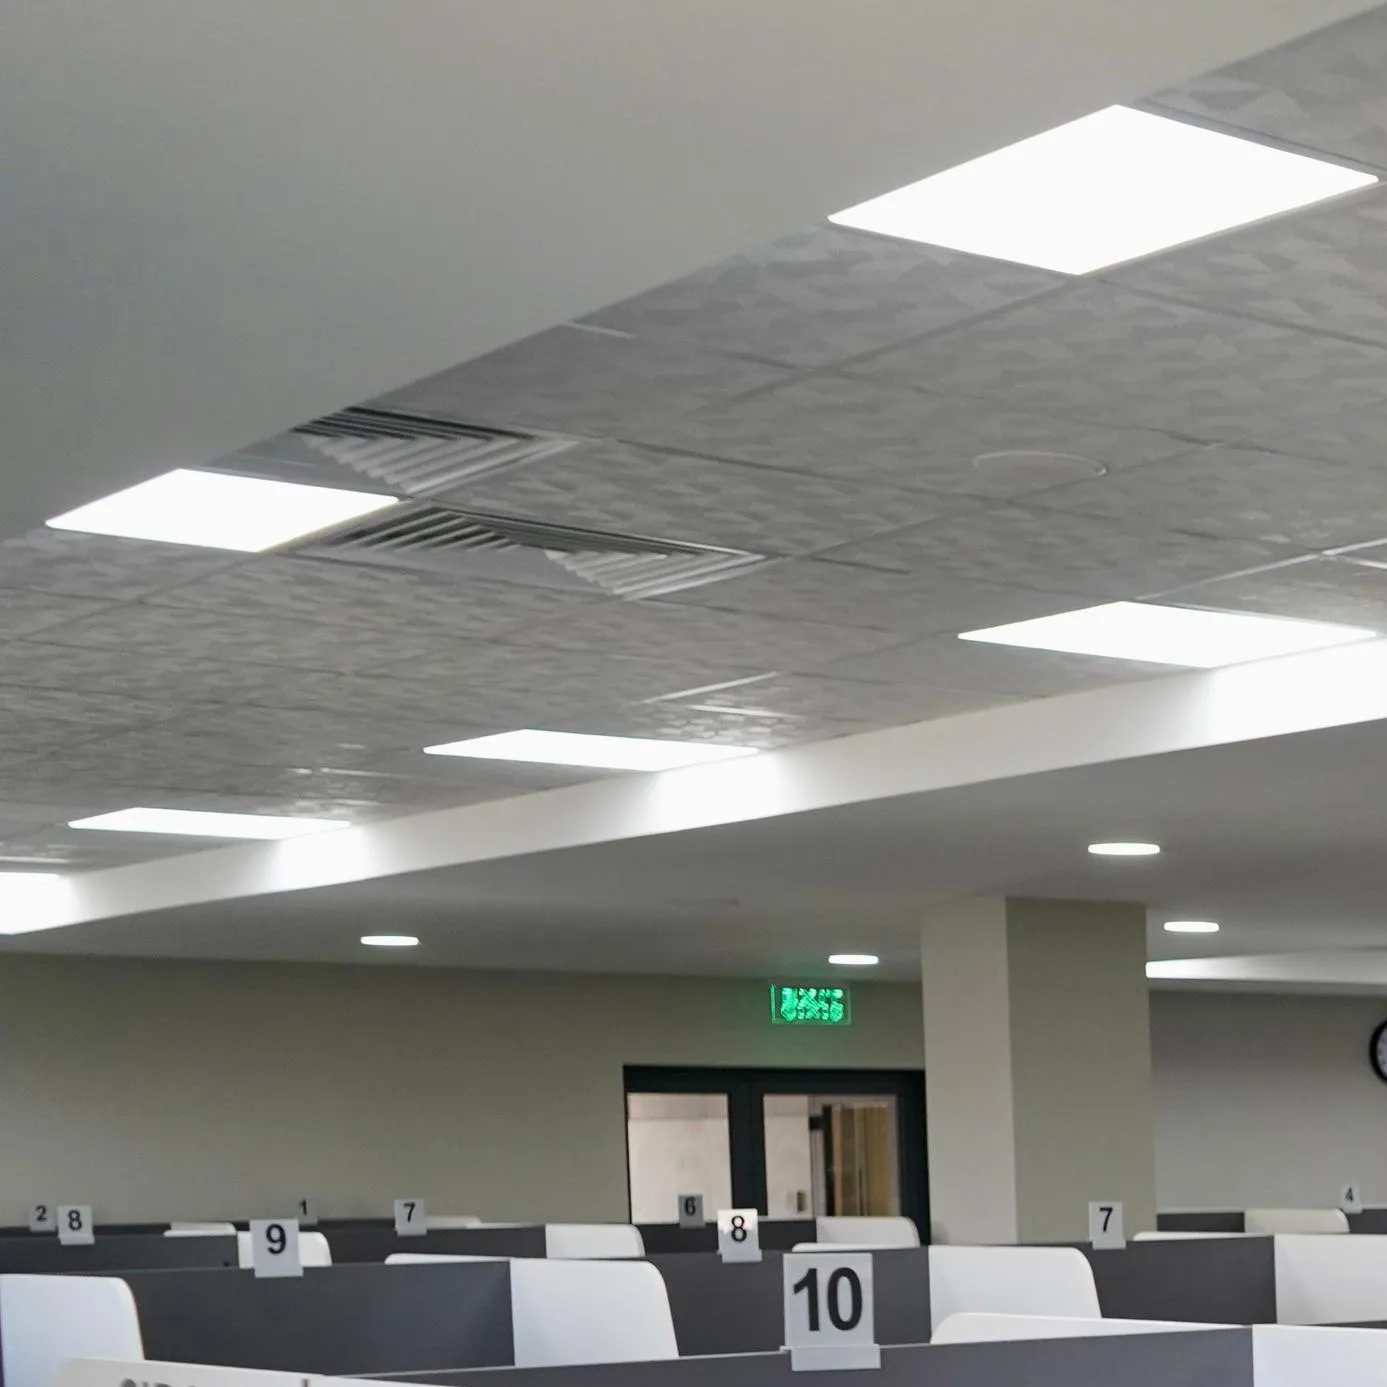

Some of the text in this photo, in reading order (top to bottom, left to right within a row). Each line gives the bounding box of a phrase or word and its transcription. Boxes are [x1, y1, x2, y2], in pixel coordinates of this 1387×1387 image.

[1344, 1187, 1354, 1202] 4
[35, 1205, 47, 1222] 2
[403, 1202, 417, 1222] 7
[684, 1196, 697, 1217] 6
[67, 1210, 82, 1231] 8
[730, 1214, 748, 1243] 8
[1099, 1206, 1114, 1232] 7
[265, 1223, 287, 1255] 9
[793, 1266, 863, 1332] 10
